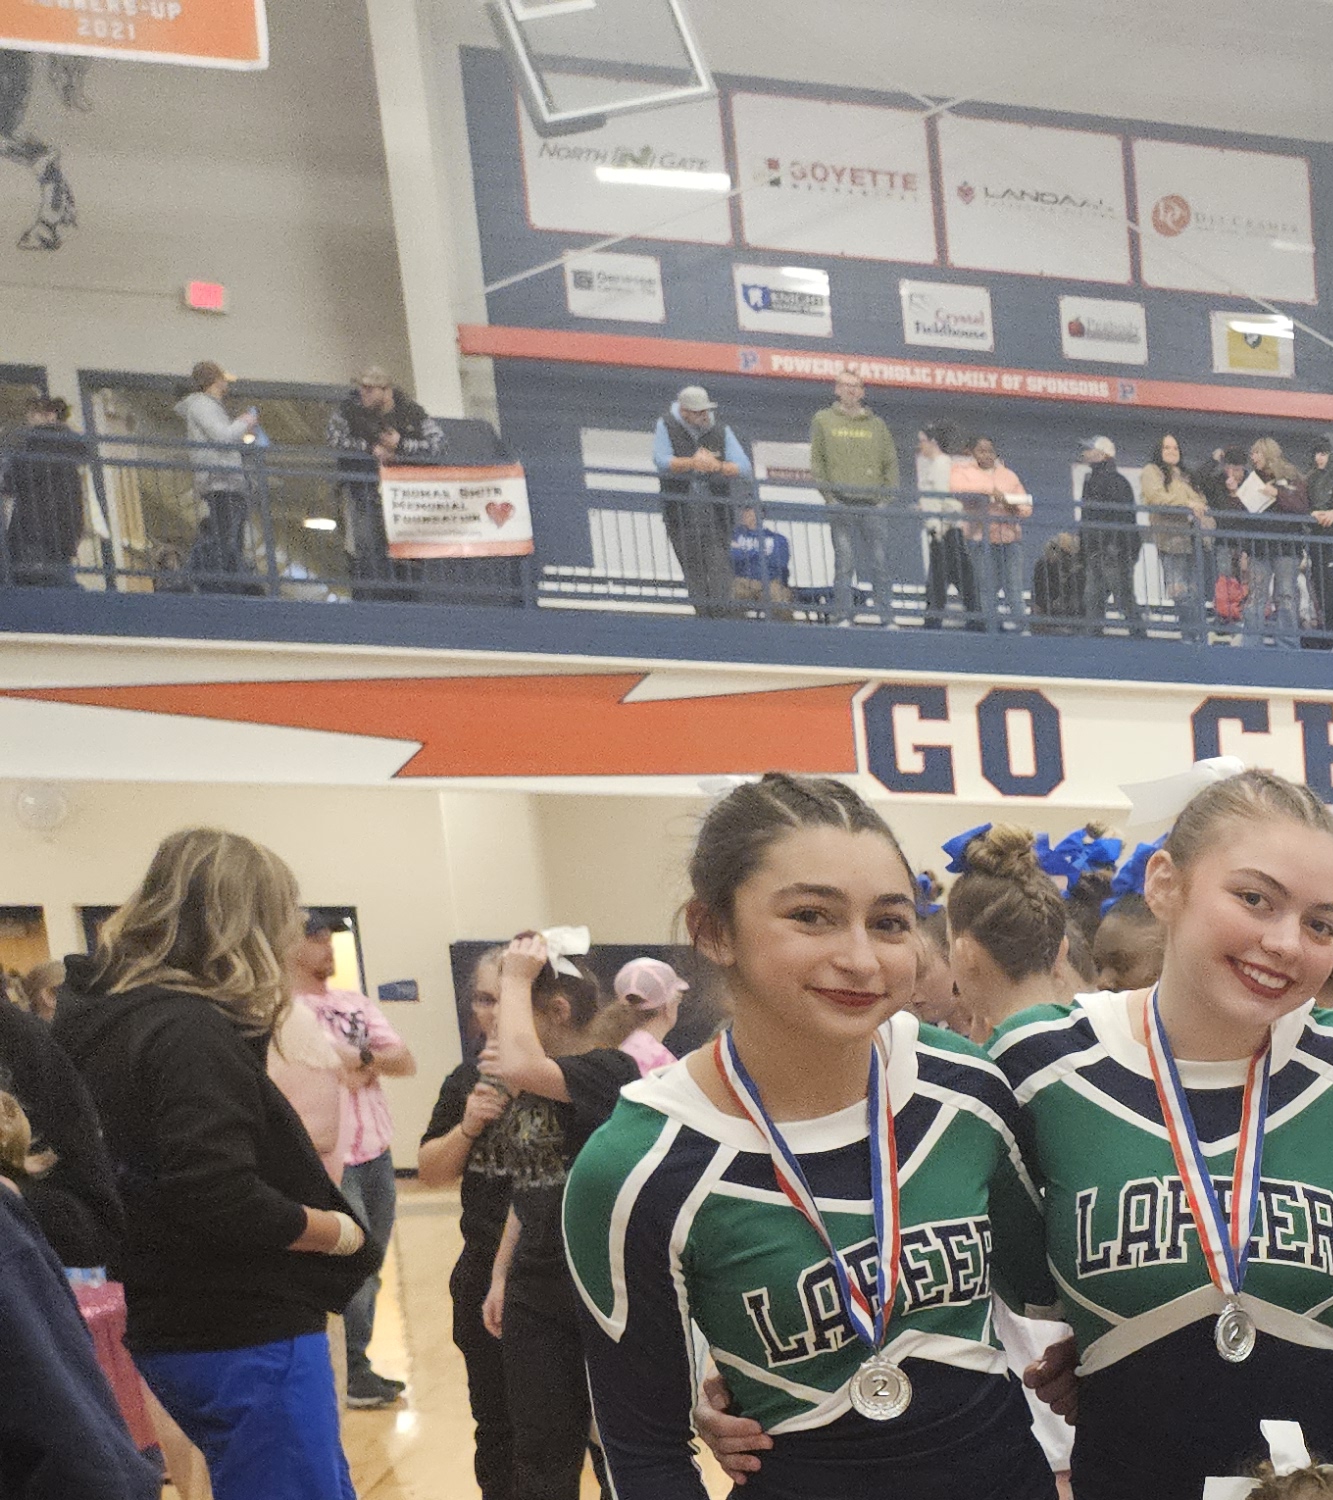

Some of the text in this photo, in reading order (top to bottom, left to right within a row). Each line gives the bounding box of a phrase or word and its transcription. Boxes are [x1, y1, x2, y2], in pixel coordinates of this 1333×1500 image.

[77, 18, 136, 40] 2021
[791, 161, 917, 191] GOYETTE
[771, 355, 844, 375] POWERS
[934, 367, 998, 389] FAMILY
[1001, 374, 1022, 390] OF
[1026, 375, 1110, 398] SPONSORS
[860, 682, 1065, 797] GO
